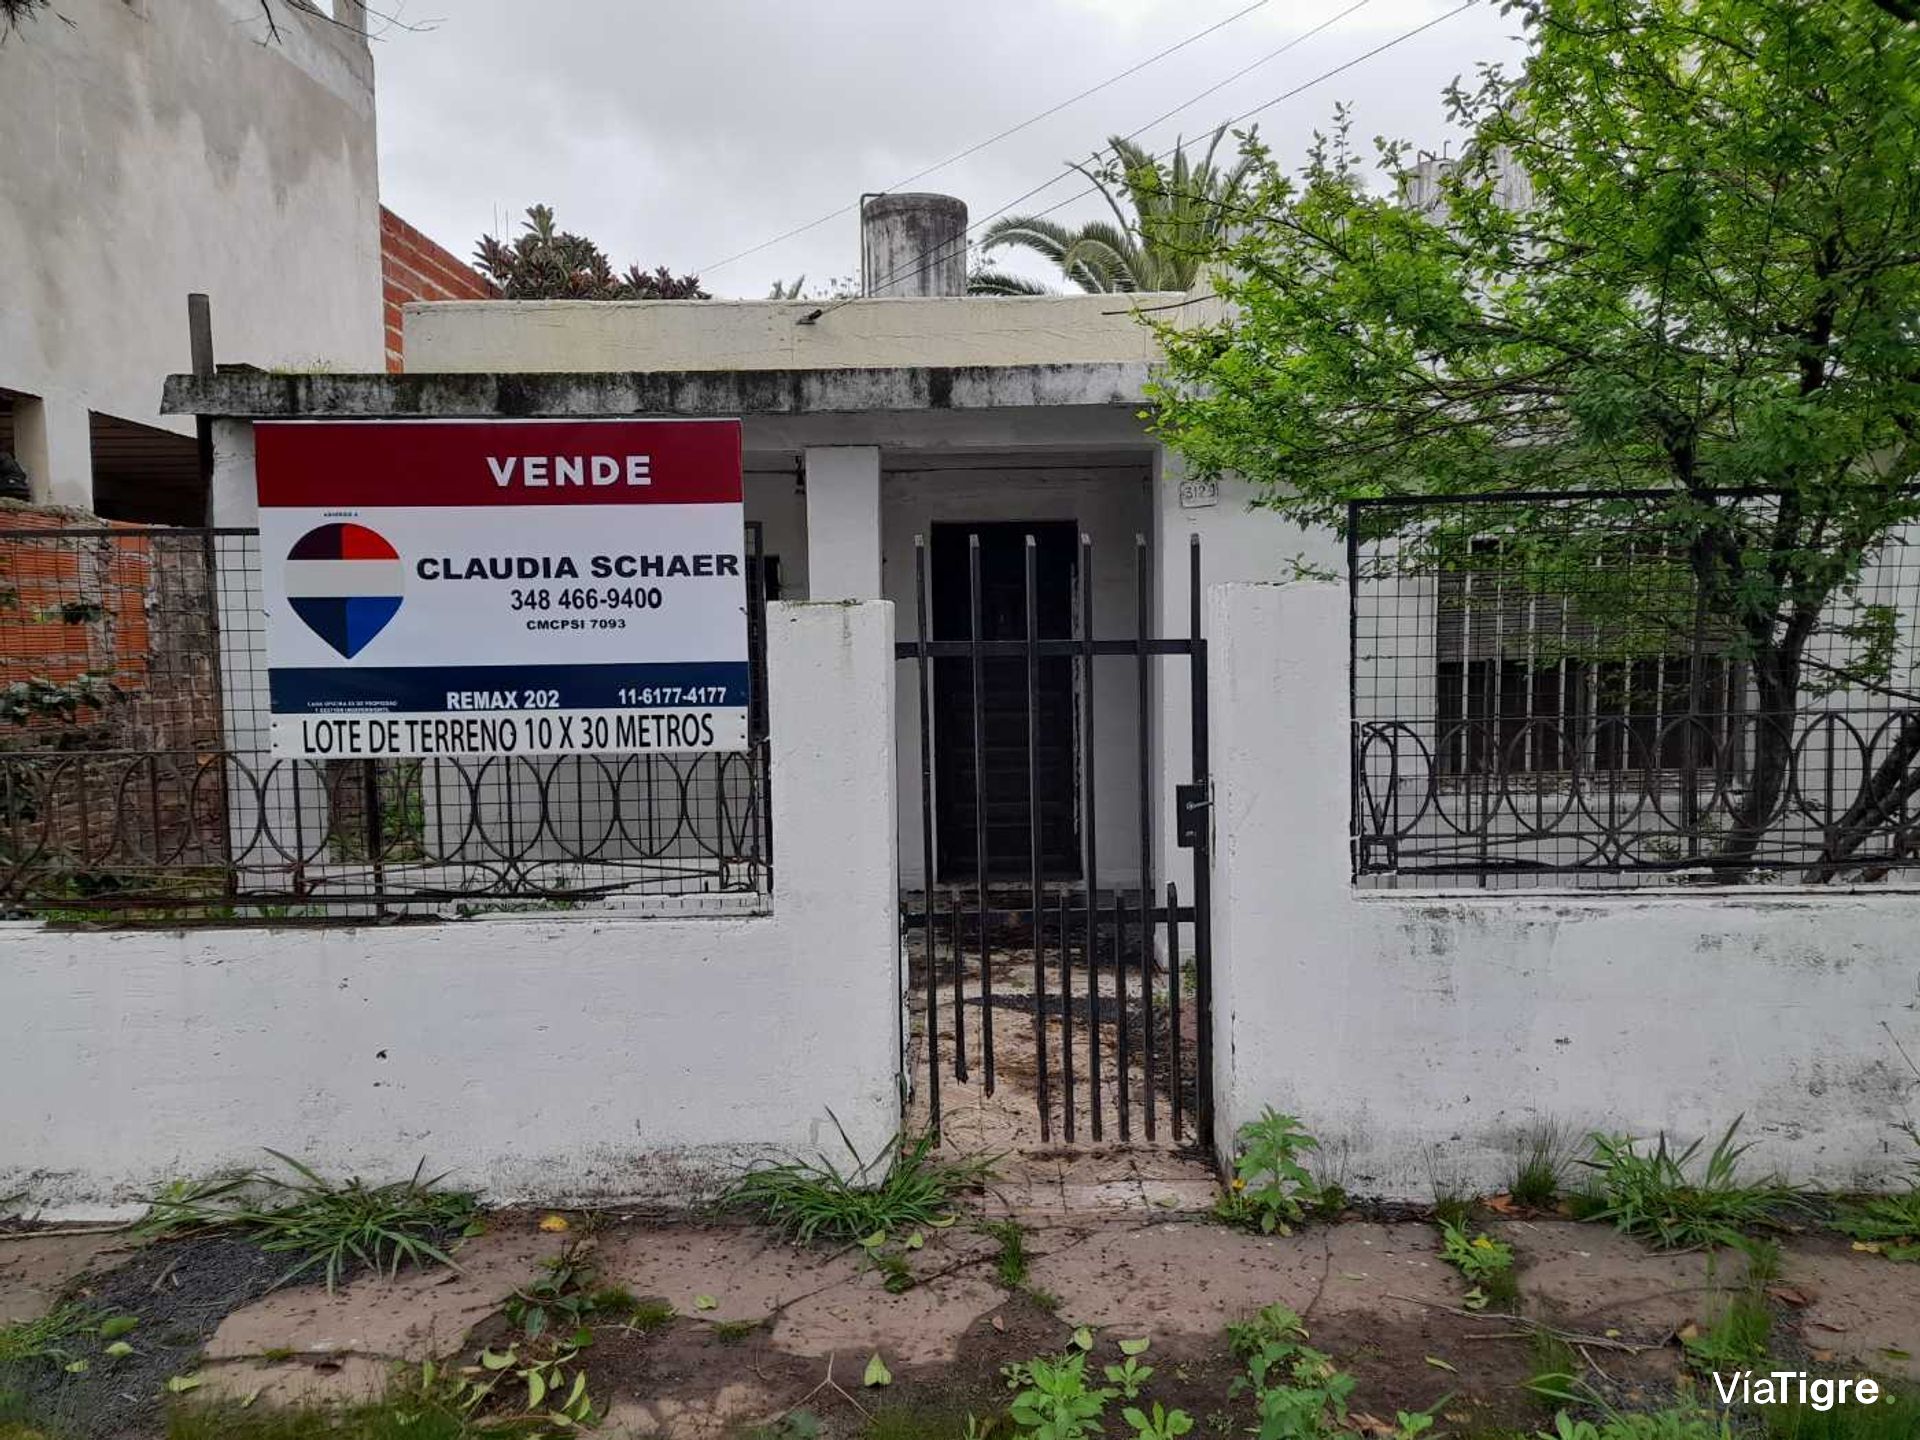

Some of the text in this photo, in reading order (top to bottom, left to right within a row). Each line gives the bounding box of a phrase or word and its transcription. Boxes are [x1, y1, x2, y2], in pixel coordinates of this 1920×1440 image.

[487, 454, 651, 487] VENDE
[416, 554, 739, 580] CLAUDIA SCHAER
[510, 587, 662, 611] 348 466-9400
[526, 618, 627, 631] CMCPSI 7093
[446, 690, 560, 710] REMAX 202
[618, 686, 727, 706] 11-6177-4177
[302, 712, 715, 754] LOTE DE TERRENO 10 X 30 METROS
